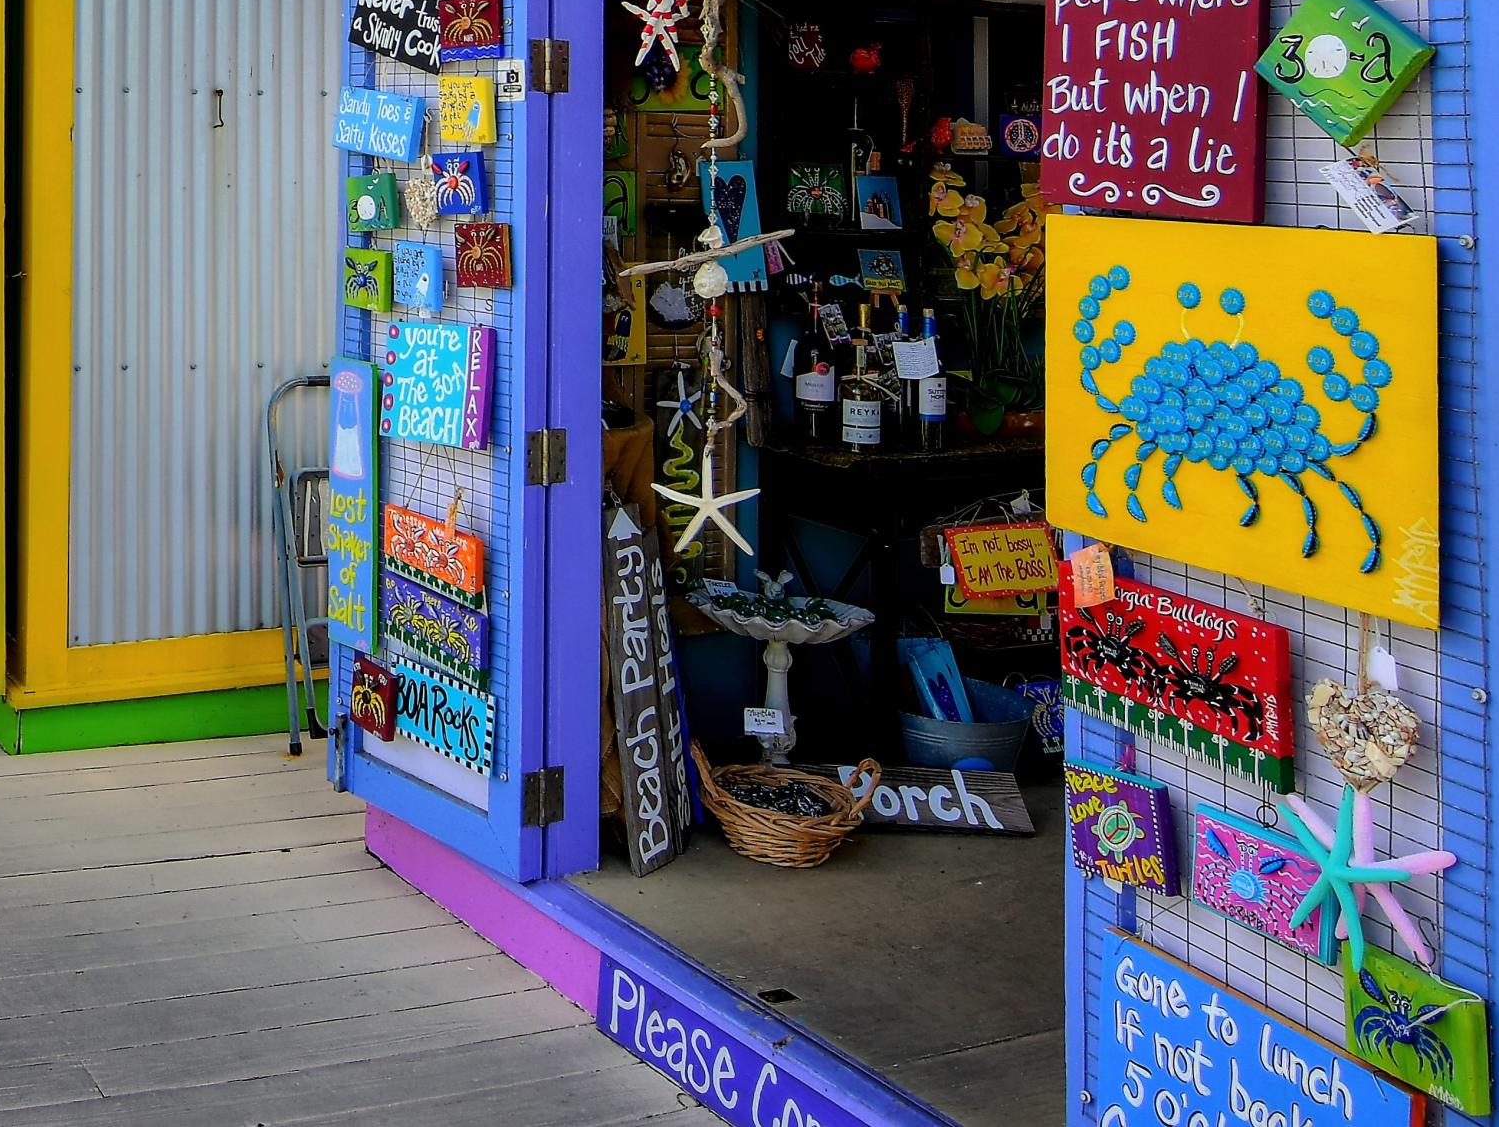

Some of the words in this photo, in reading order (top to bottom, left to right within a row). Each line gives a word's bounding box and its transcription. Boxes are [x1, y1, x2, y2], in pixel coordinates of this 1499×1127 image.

[353, 16, 363, 32] a
[405, 29, 441, 70] Cook
[1061, 23, 1070, 63] I
[1095, 17, 1176, 62] FISH
[340, 90, 370, 125] Sandy
[377, 94, 401, 123] Toes
[1047, 68, 1110, 114] But
[1123, 70, 1211, 126] when
[1232, 70, 1248, 123] I
[336, 119, 365, 151] Salty
[368, 123, 406, 158] Kisses
[1042, 121, 1080, 161] do
[1092, 120, 1133, 169] it's
[1146, 137, 1168, 172] a
[400, 325, 462, 360] you're
[413, 349, 438, 379] at
[397, 376, 428, 405] The
[465, 330, 482, 438] RELAX
[330, 488, 367, 525] Lost
[960, 536, 979, 555] I'm
[982, 532, 1002, 555] not
[339, 562, 357, 590] of
[964, 565, 977, 583] I
[979, 564, 994, 586] AM
[327, 585, 367, 634] Salt
[612, 544, 653, 695] Party
[1114, 585, 1155, 612] orgia
[1156, 595, 1240, 642] Bulldogs
[397, 672, 429, 732] BOA
[626, 704, 670, 866] Beach
[1065, 770, 1118, 795] Peace
[609, 969, 739, 1110] Please
[1115, 956, 1191, 1018] Gone
[1200, 992, 1239, 1046] to
[1259, 1022, 1353, 1120] lunch
[1115, 1000, 1145, 1052] If
[1153, 1032, 1214, 1097] not
[1122, 1059, 1152, 1107] 5
